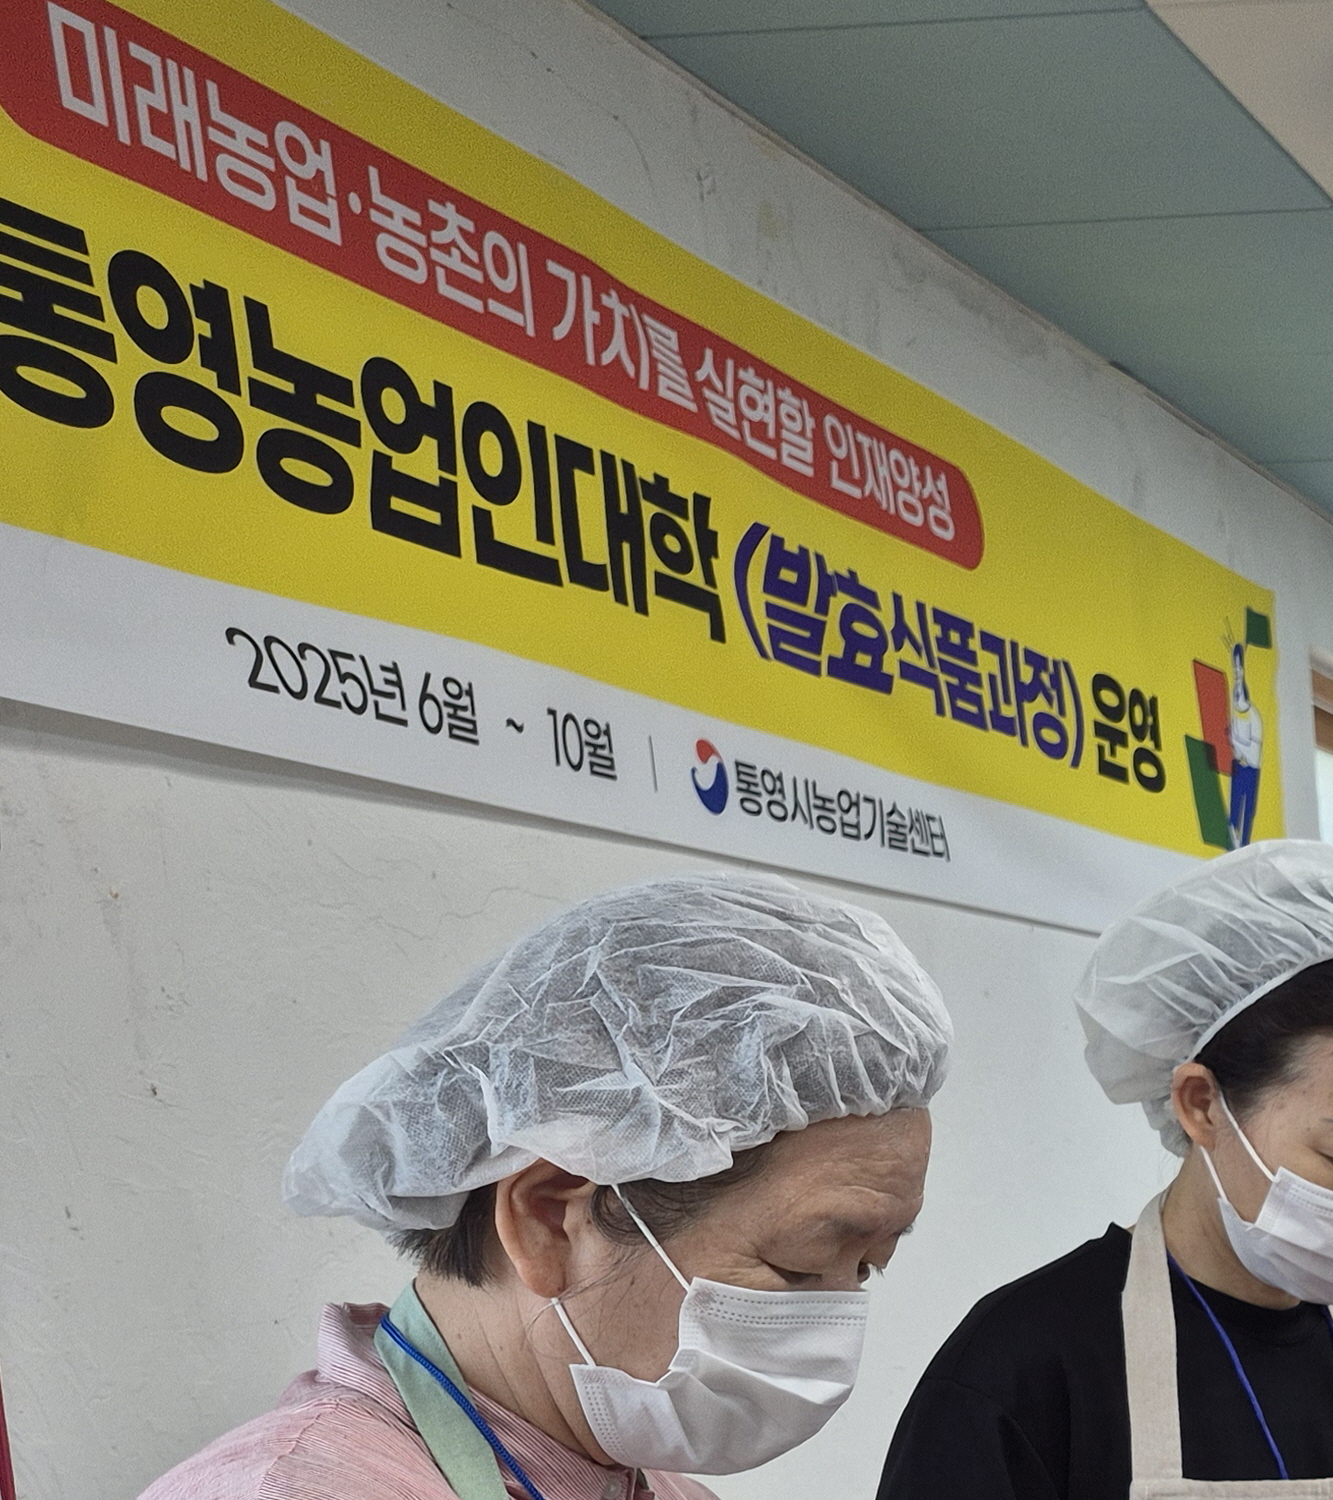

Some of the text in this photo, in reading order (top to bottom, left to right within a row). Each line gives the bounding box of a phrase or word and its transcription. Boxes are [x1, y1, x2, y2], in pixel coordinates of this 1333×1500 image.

[47, 1, 957, 542] 미래농업·농촌의 가치를 실현할 인재양성
[225, 626, 409, 728] 2025년
[418, 671, 480, 746] 6월
[545, 707, 618, 782] 10월
[1090, 671, 1167, 794] 운영
[733, 758, 952, 863] 통영시농업기술센터
